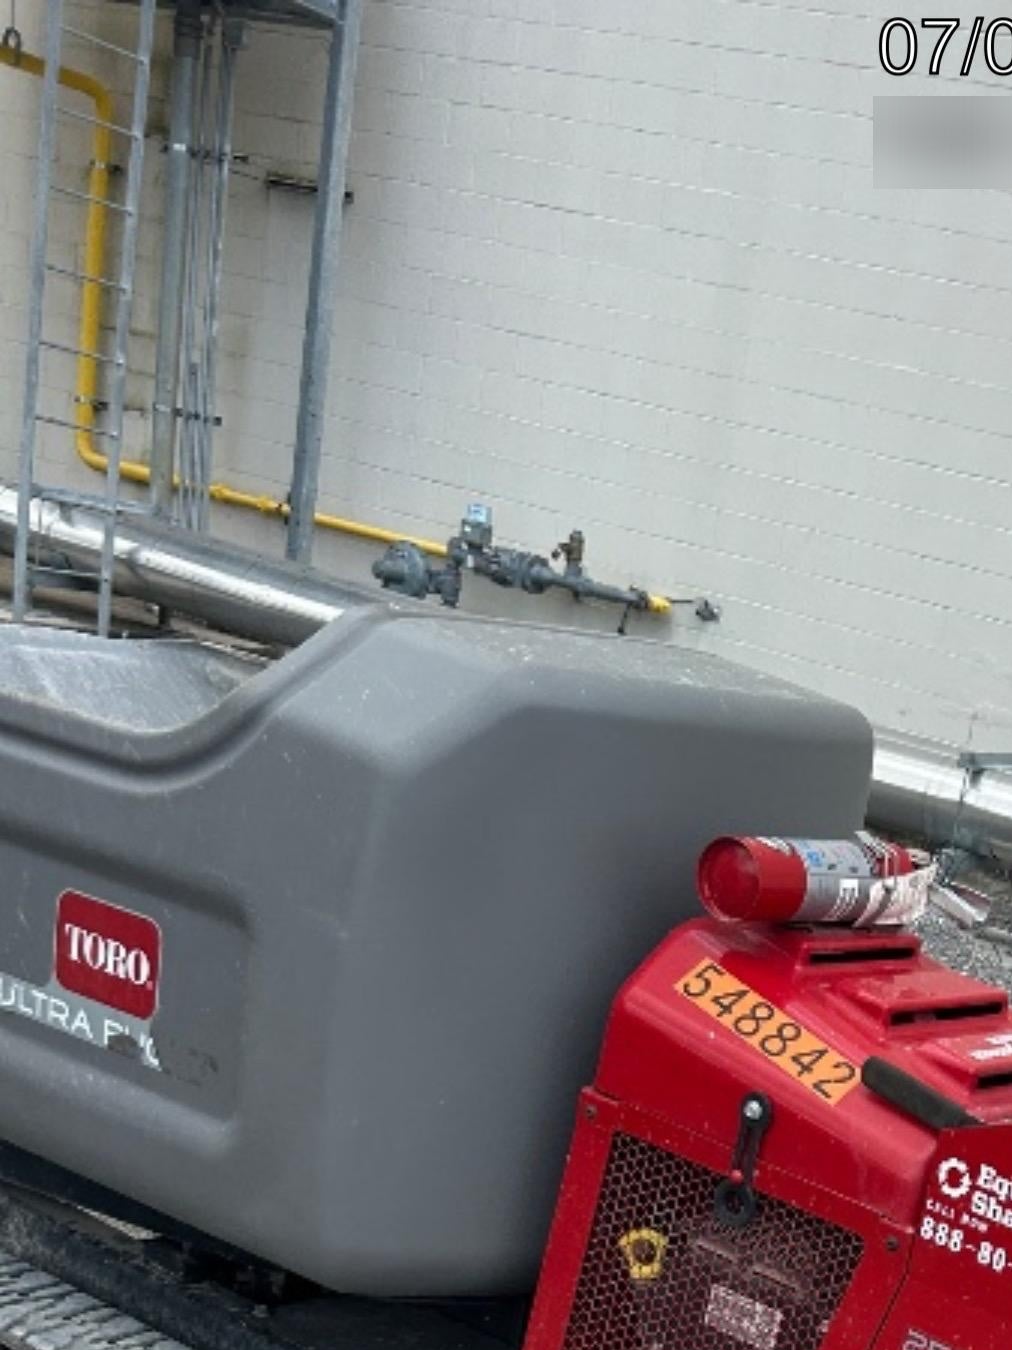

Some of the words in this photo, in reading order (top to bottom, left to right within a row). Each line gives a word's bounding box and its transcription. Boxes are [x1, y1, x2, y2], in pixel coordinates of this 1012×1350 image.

[64, 922, 150, 986] TORO
[0, 977, 93, 1040] ULTRA
[682, 963, 856, 1099] 548842
